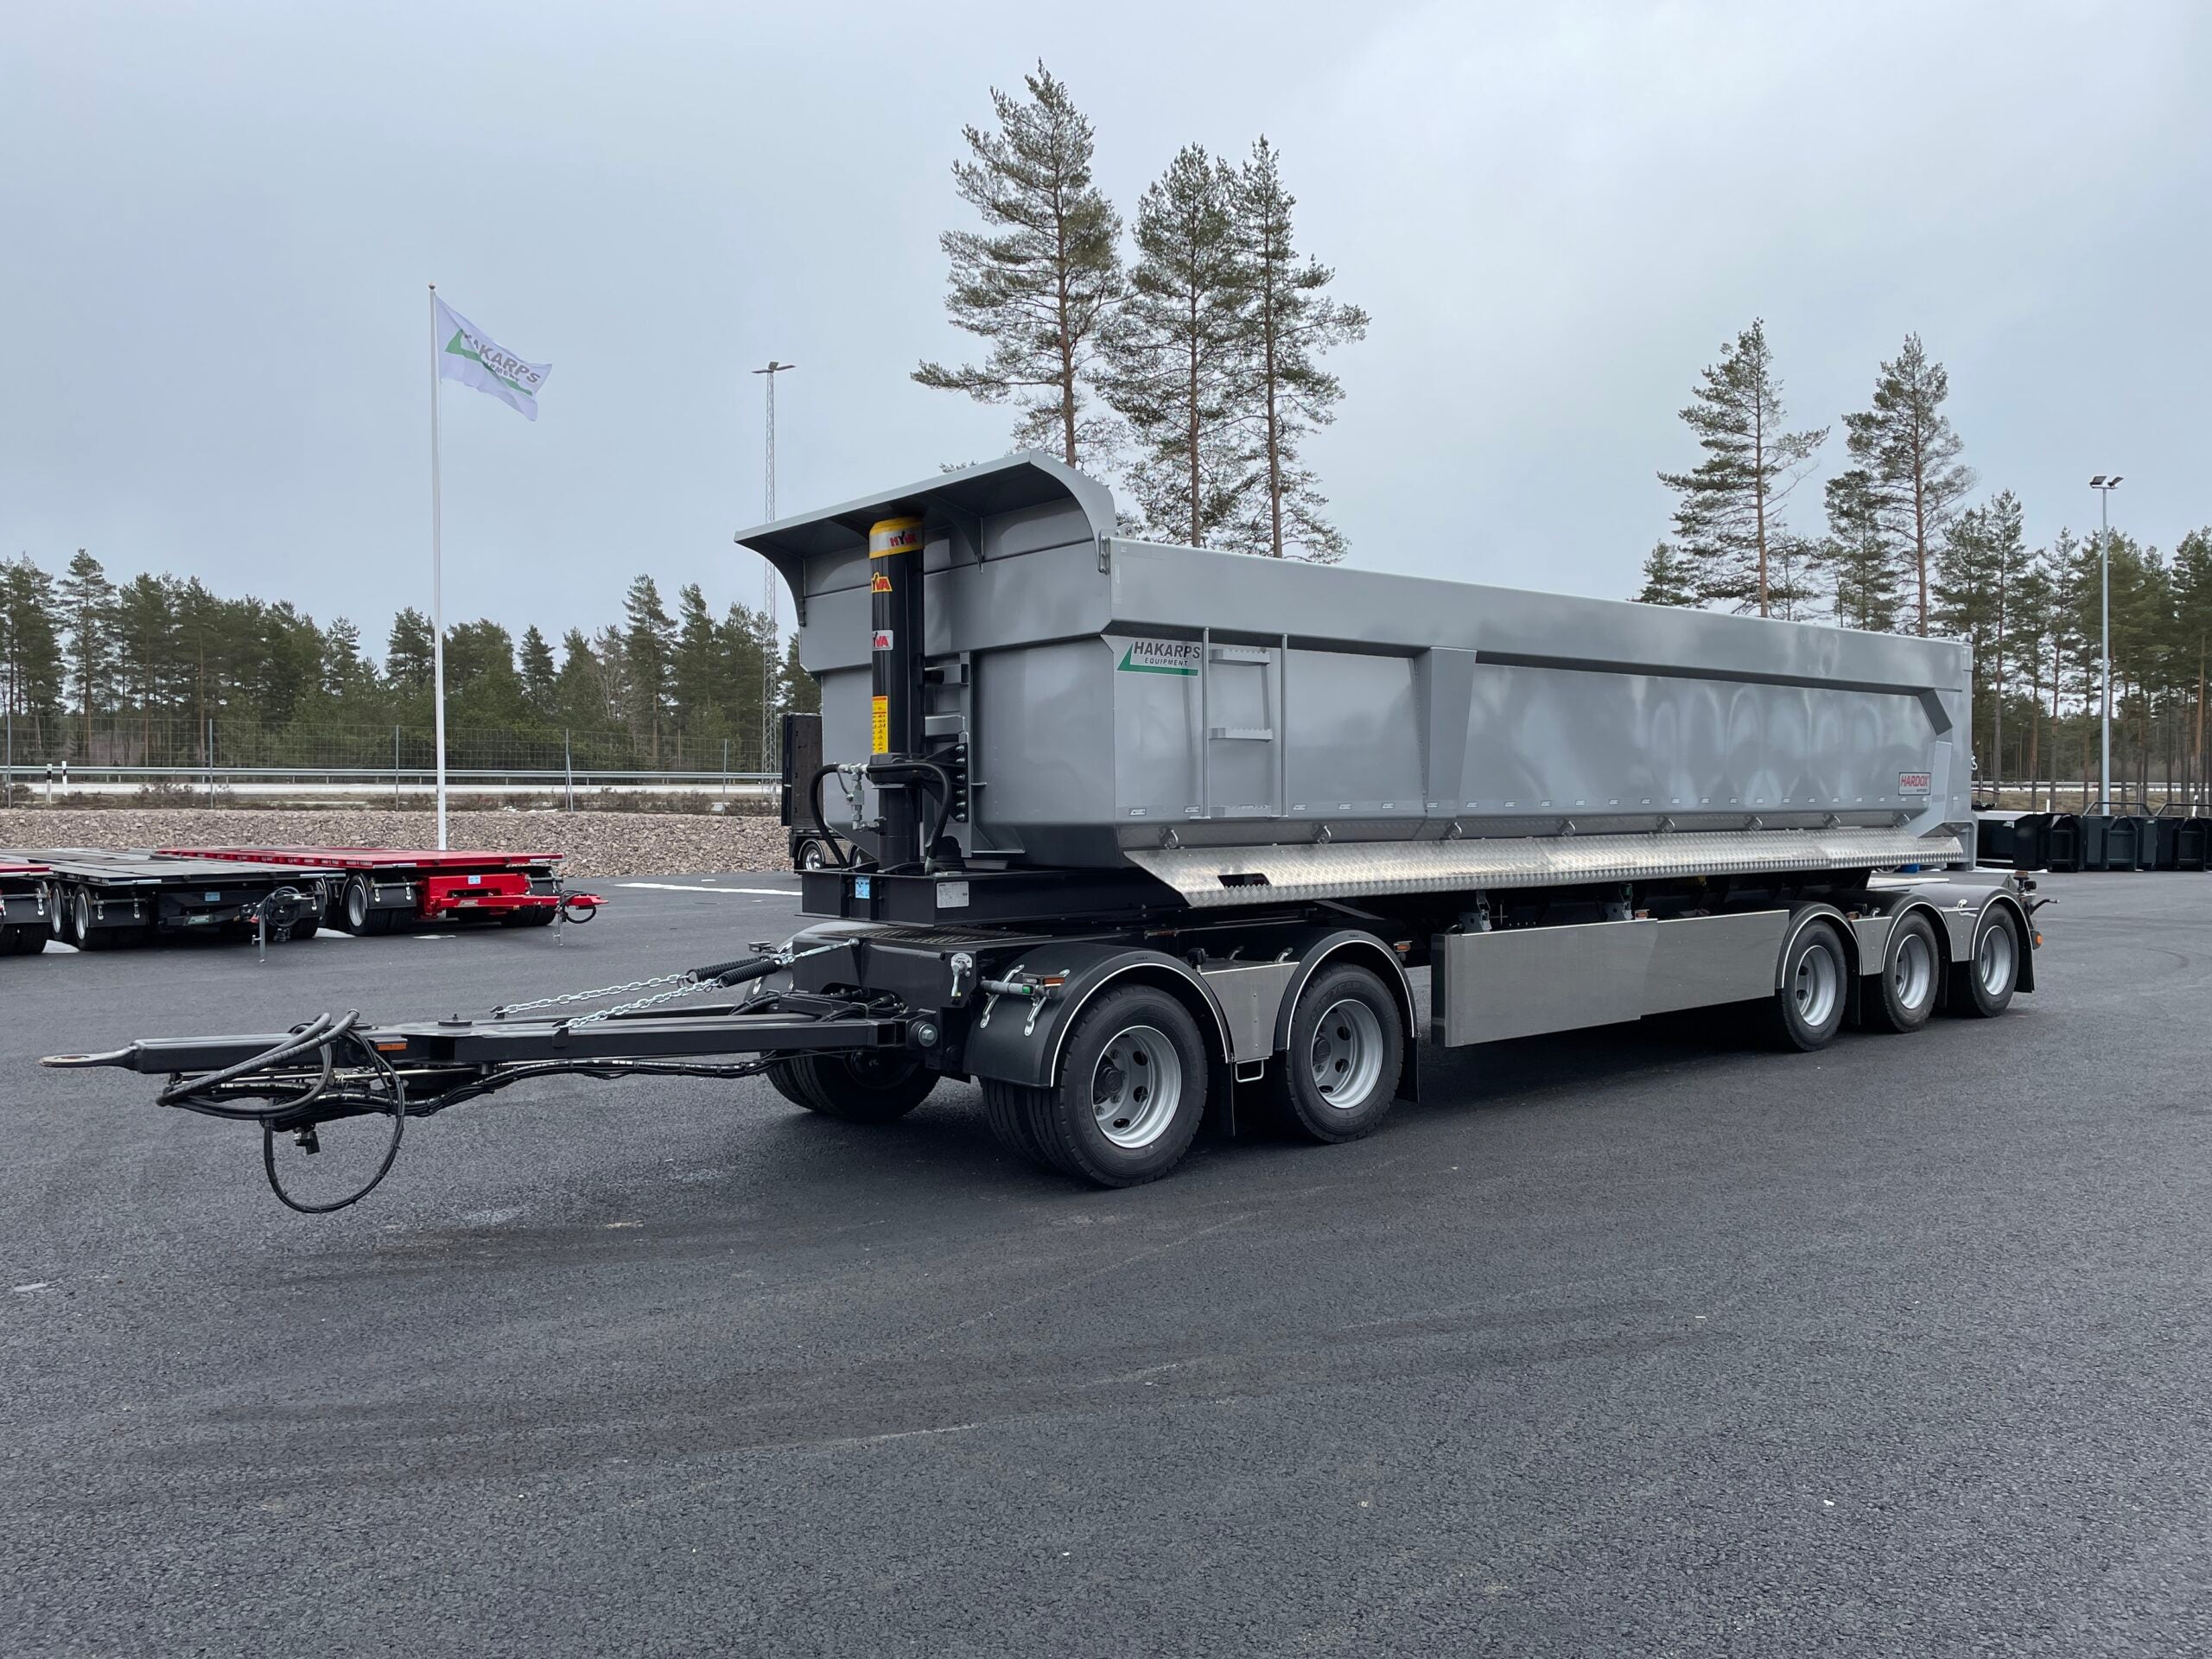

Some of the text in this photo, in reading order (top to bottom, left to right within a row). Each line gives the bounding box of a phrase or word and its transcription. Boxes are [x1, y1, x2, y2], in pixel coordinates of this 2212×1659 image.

[464, 334, 541, 383] AKARPS
[1134, 641, 1201, 659] HAKARPS
[1144, 658, 1189, 666] EQUIPMENT
